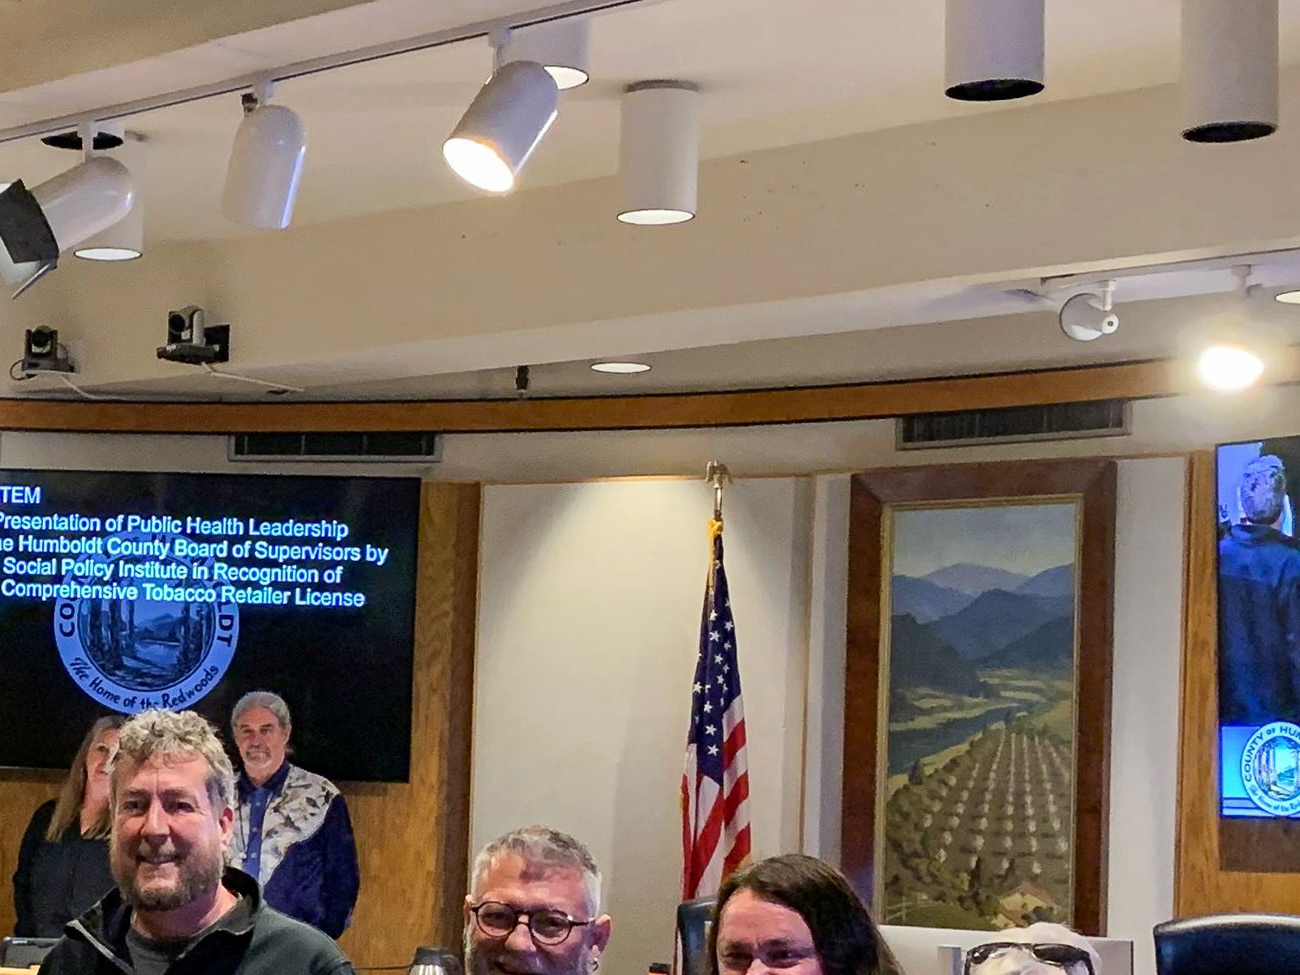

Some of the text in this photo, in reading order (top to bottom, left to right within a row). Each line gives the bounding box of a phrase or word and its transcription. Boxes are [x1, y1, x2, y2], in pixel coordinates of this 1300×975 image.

[105, 515, 124, 532] of
[127, 515, 182, 533] Public
[186, 516, 244, 535] Health
[249, 518, 349, 541] Leadership
[18, 535, 102, 554] Humboldt
[107, 538, 170, 559] County
[174, 539, 228, 557] Board
[232, 540, 252, 558] of
[254, 541, 361, 563] Supervisors
[365, 544, 389, 566] by
[3, 557, 56, 575] Social
[61, 558, 114, 581] Policy
[119, 560, 187, 579] Institute
[192, 562, 208, 579] in
[213, 562, 319, 585] Recognition
[323, 566, 344, 583] of
[1, 579, 138, 601] Comprehensive
[142, 583, 216, 602] Tobacco
[221, 586, 291, 604] Retailer
[295, 588, 365, 607] License
[69, 657, 91, 680] The
[89, 676, 121, 704] Home
[123, 695, 137, 709] of
[161, 664, 219, 709] Redwoods
[1244, 732, 1263, 782] COUNTY
